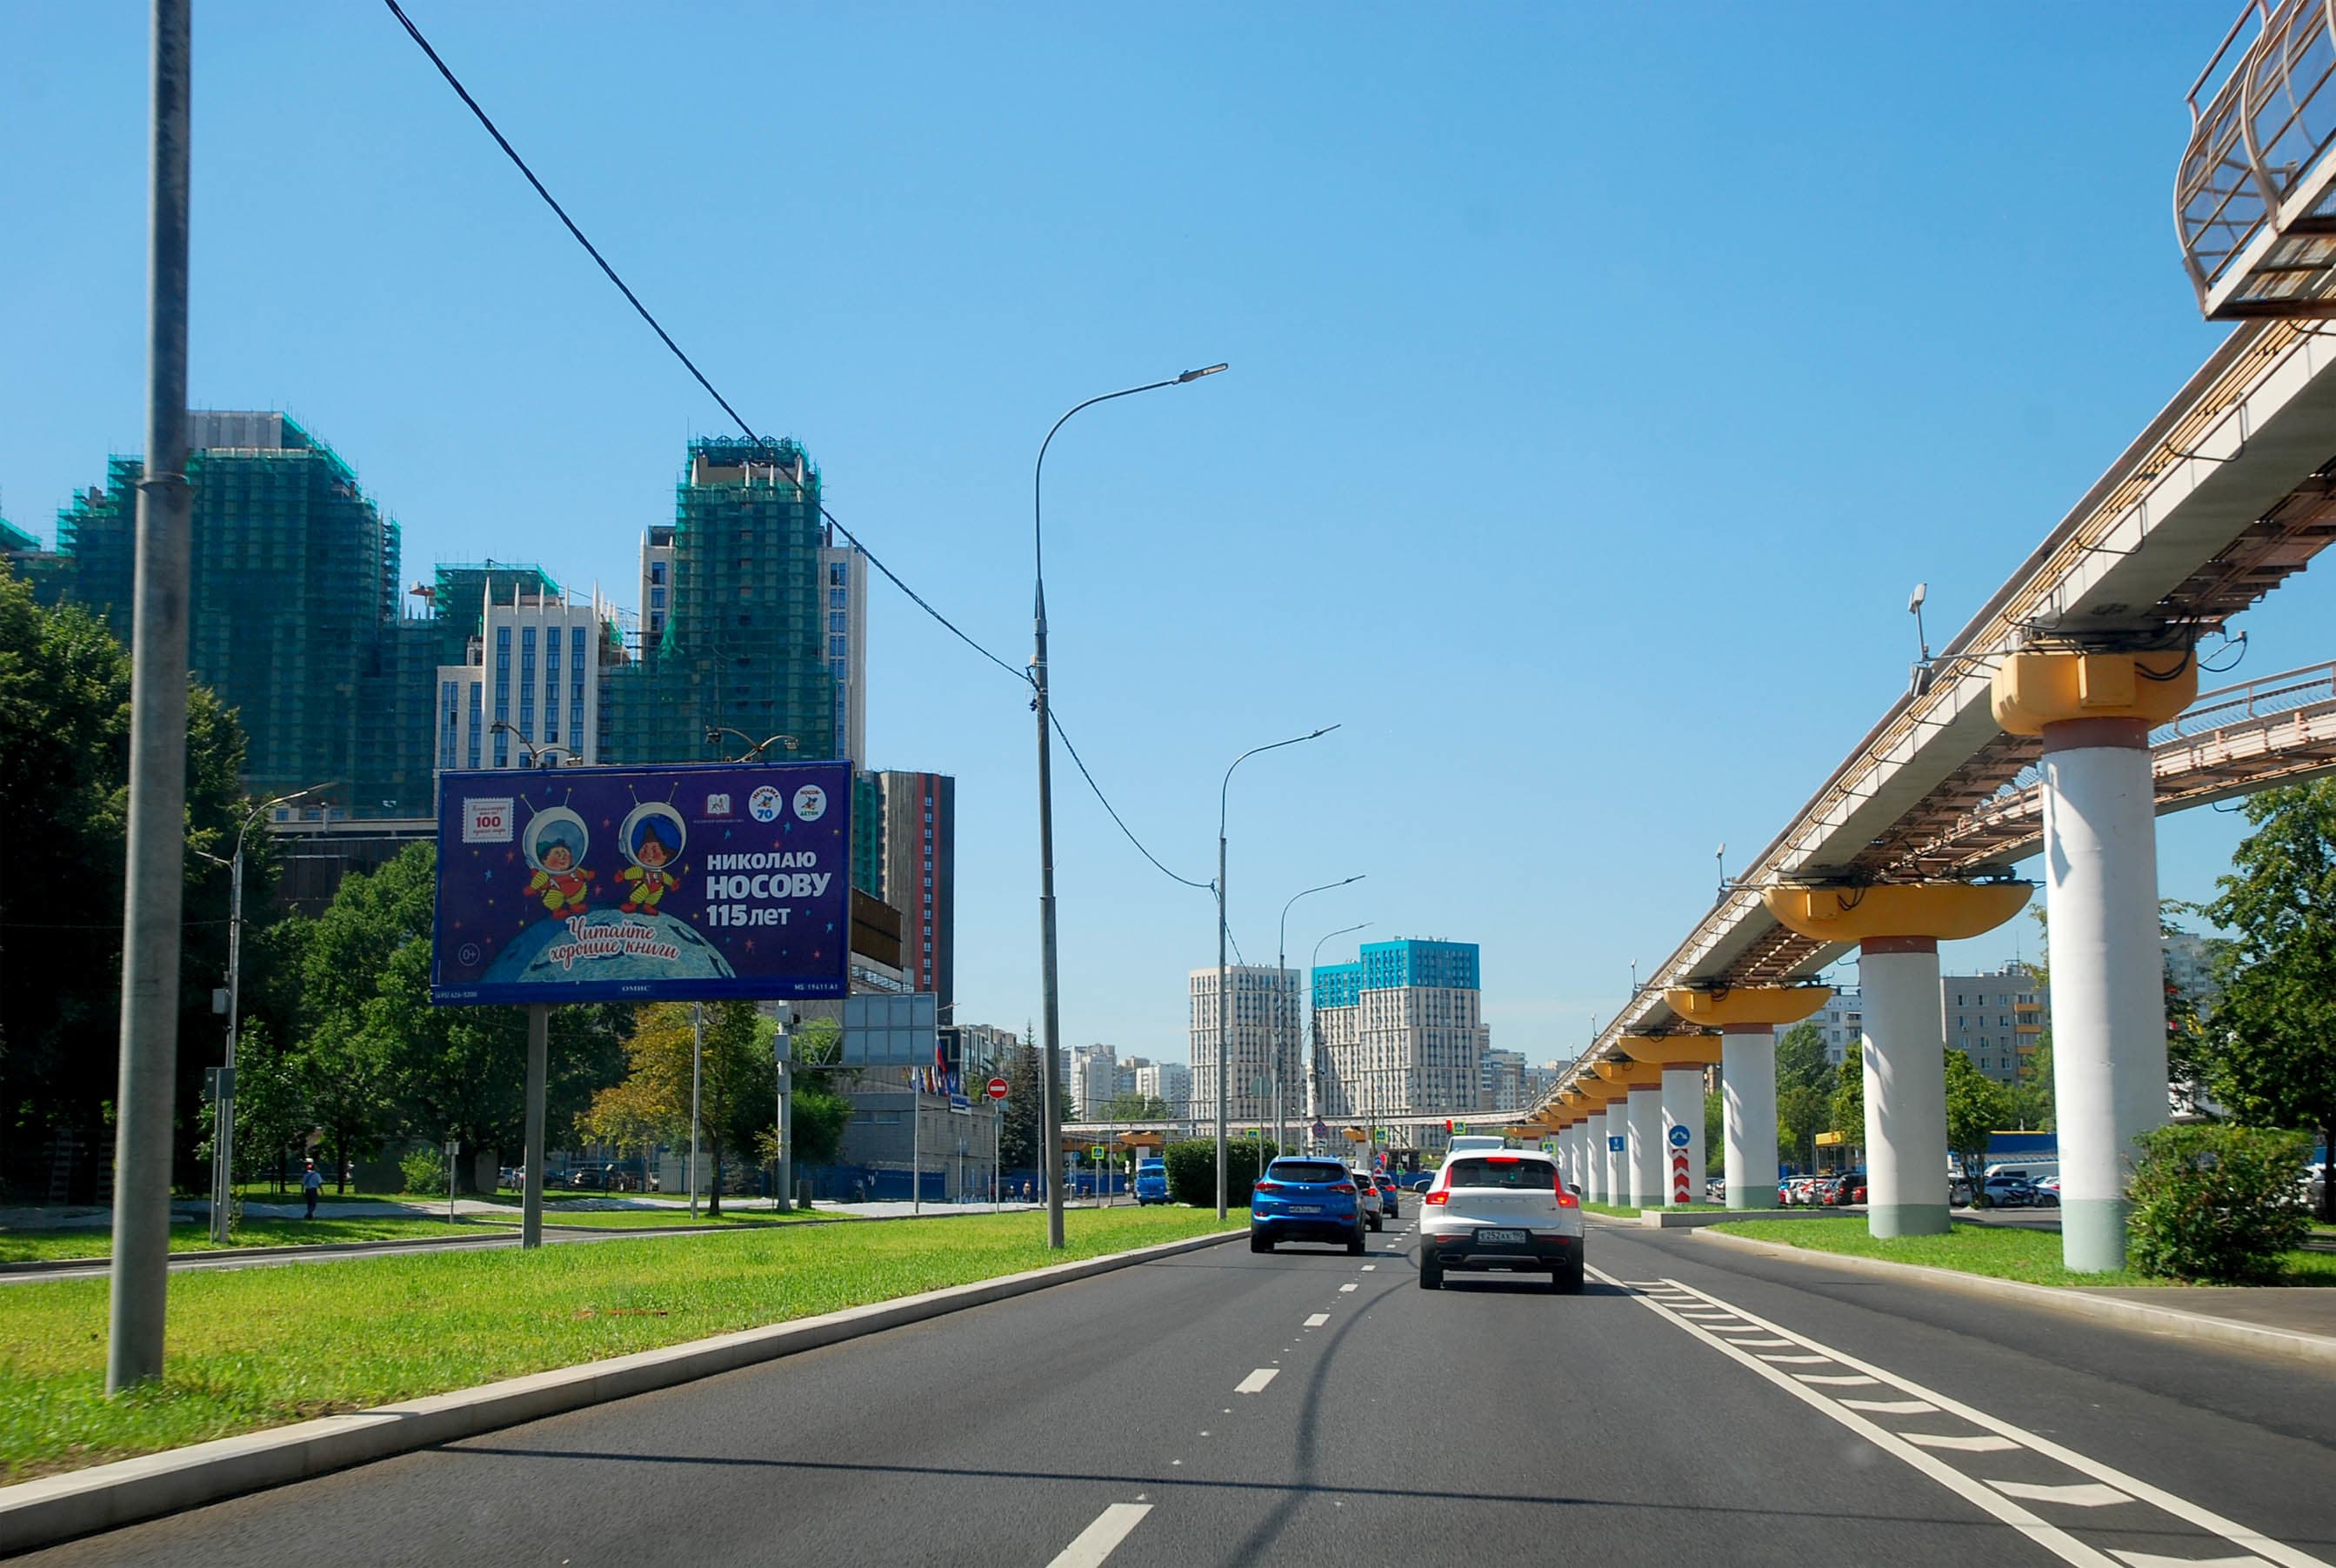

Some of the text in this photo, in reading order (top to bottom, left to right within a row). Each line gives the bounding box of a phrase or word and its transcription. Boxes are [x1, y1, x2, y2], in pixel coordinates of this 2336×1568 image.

[476, 816, 501, 828] 100
[758, 809, 773, 819] 70
[707, 851, 817, 871] НИКОЛАЮ
[706, 872, 831, 900] НОСОВУ
[706, 904, 791, 926] 115 лет
[567, 917, 656, 941] Читайте
[462, 949, 477, 960] 0+
[550, 940, 679, 969] хорошие книги
